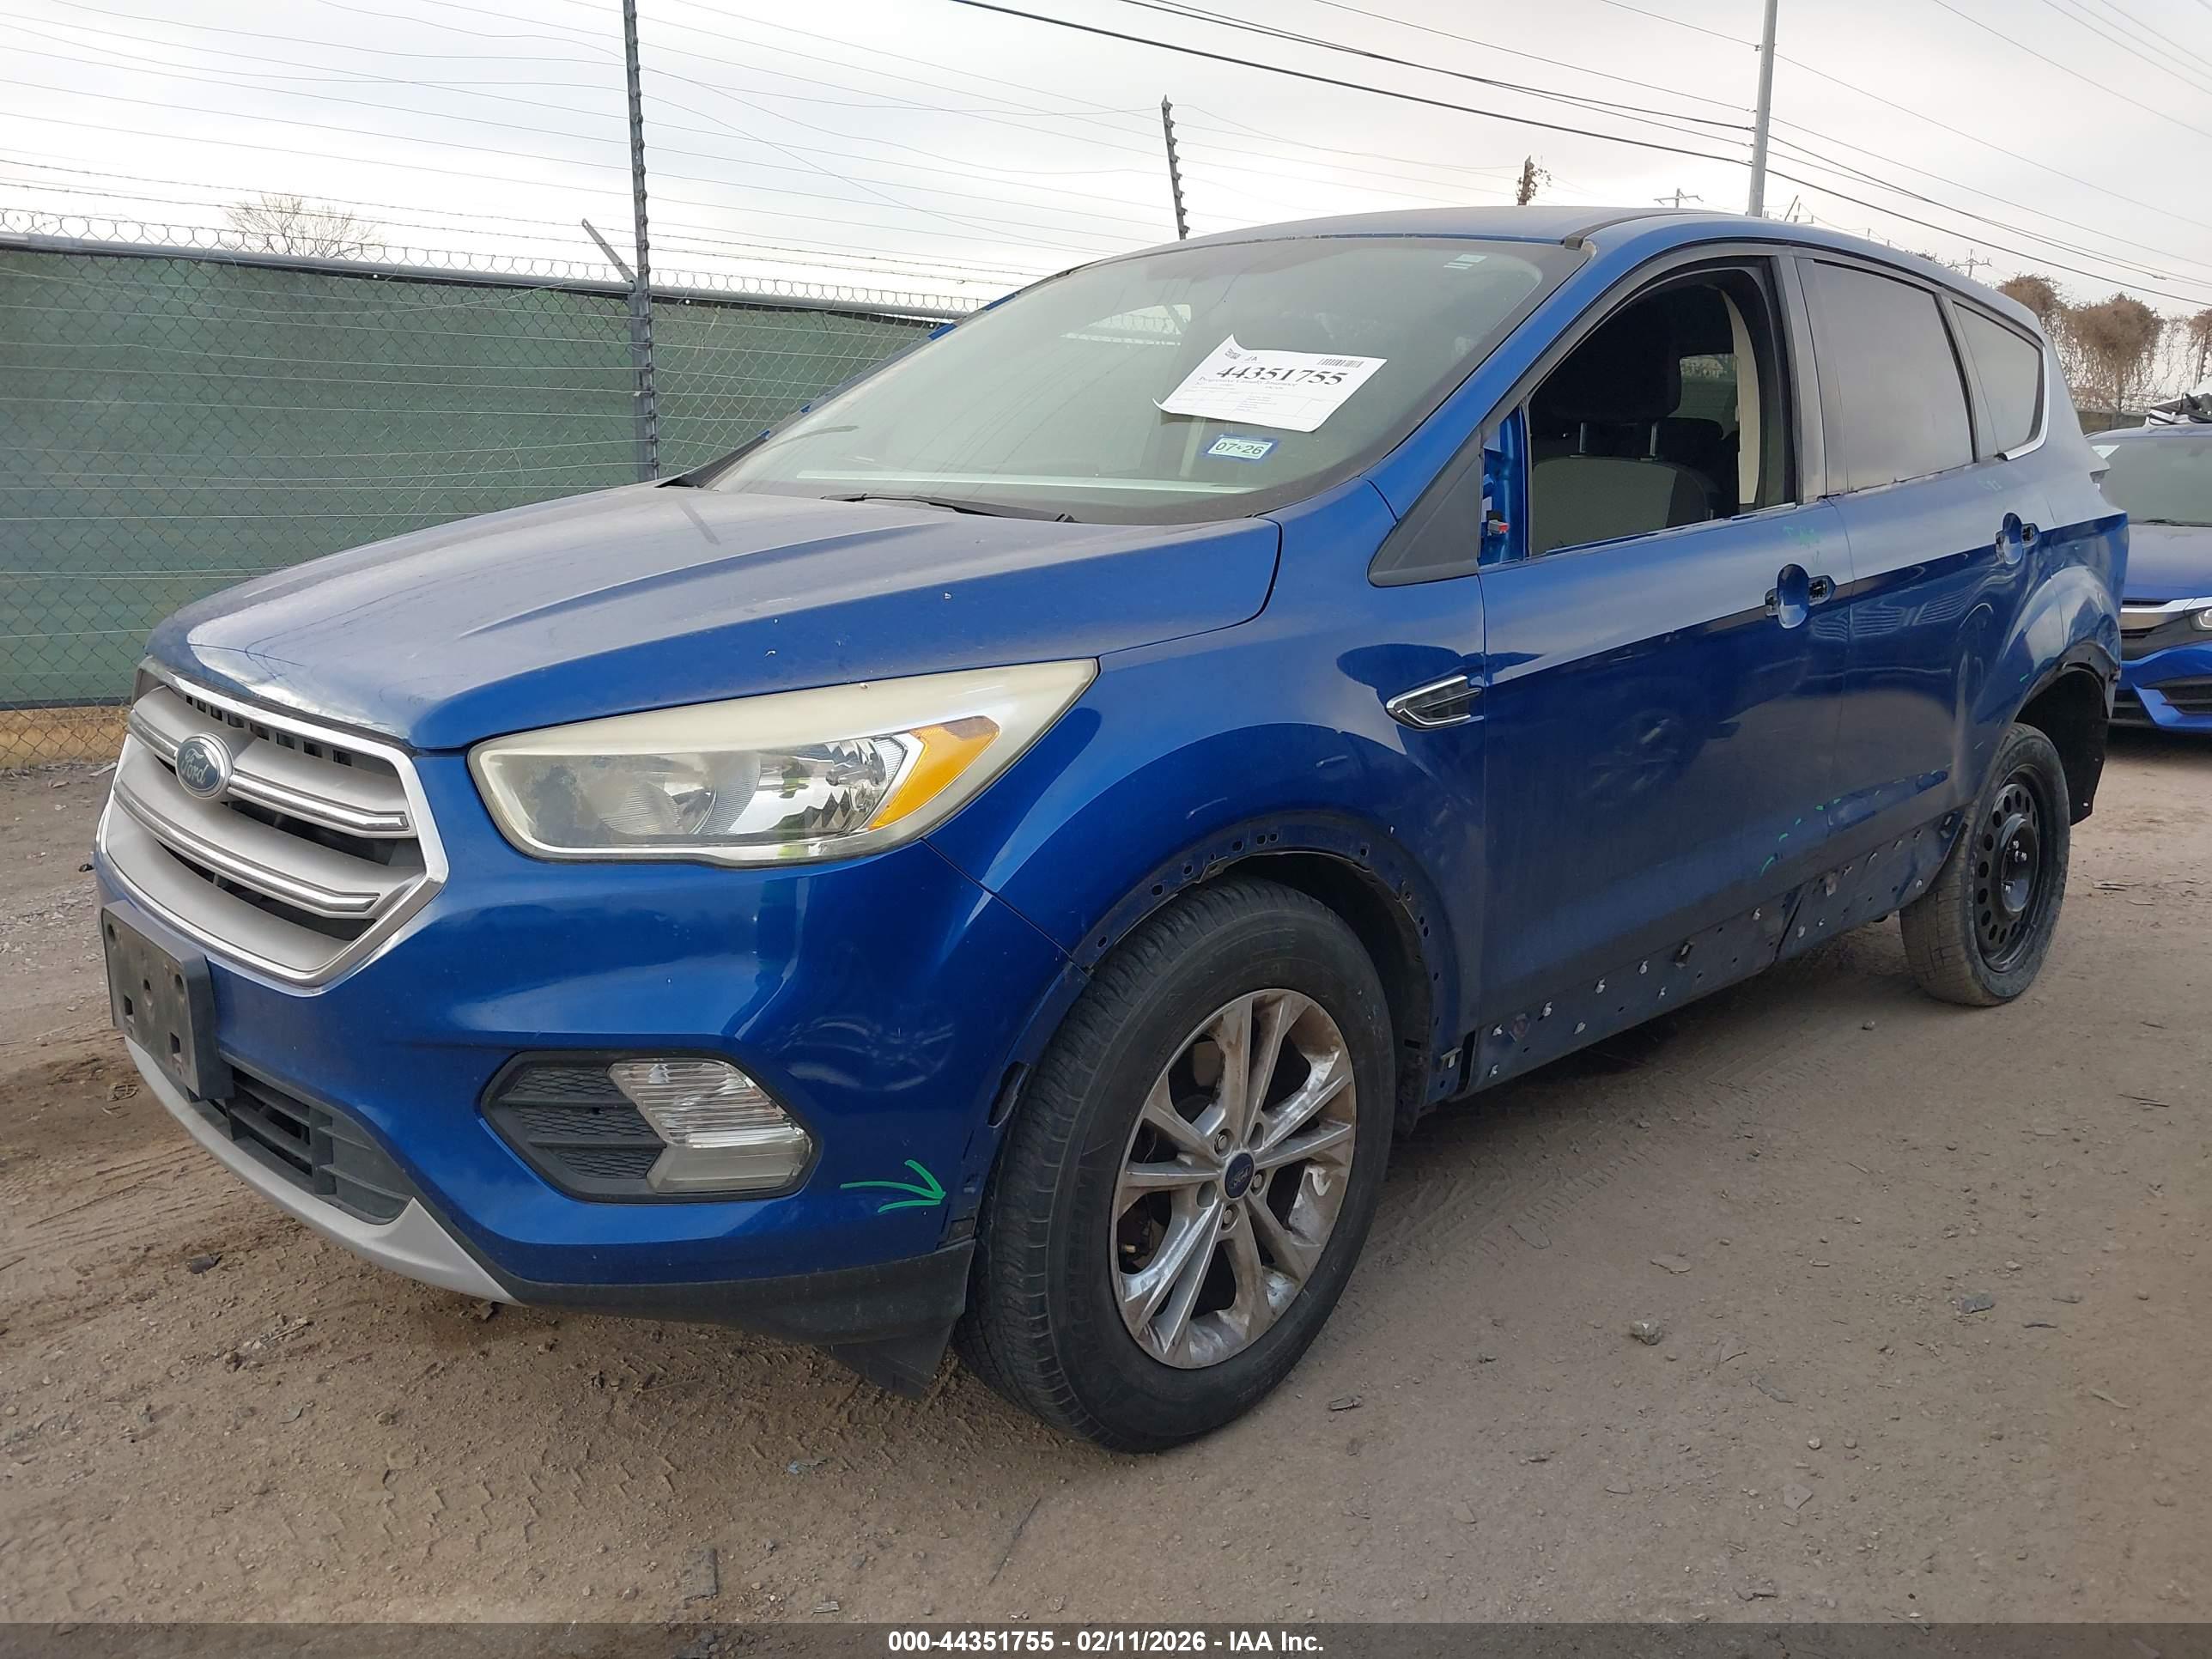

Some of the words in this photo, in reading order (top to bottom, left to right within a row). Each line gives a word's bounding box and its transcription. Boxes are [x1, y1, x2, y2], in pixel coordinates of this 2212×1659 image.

[1216, 366, 1348, 385] 44351755
[1215, 442, 1237, 452] 07
[1242, 445, 1265, 455] 26
[180, 748, 209, 784] Ford
